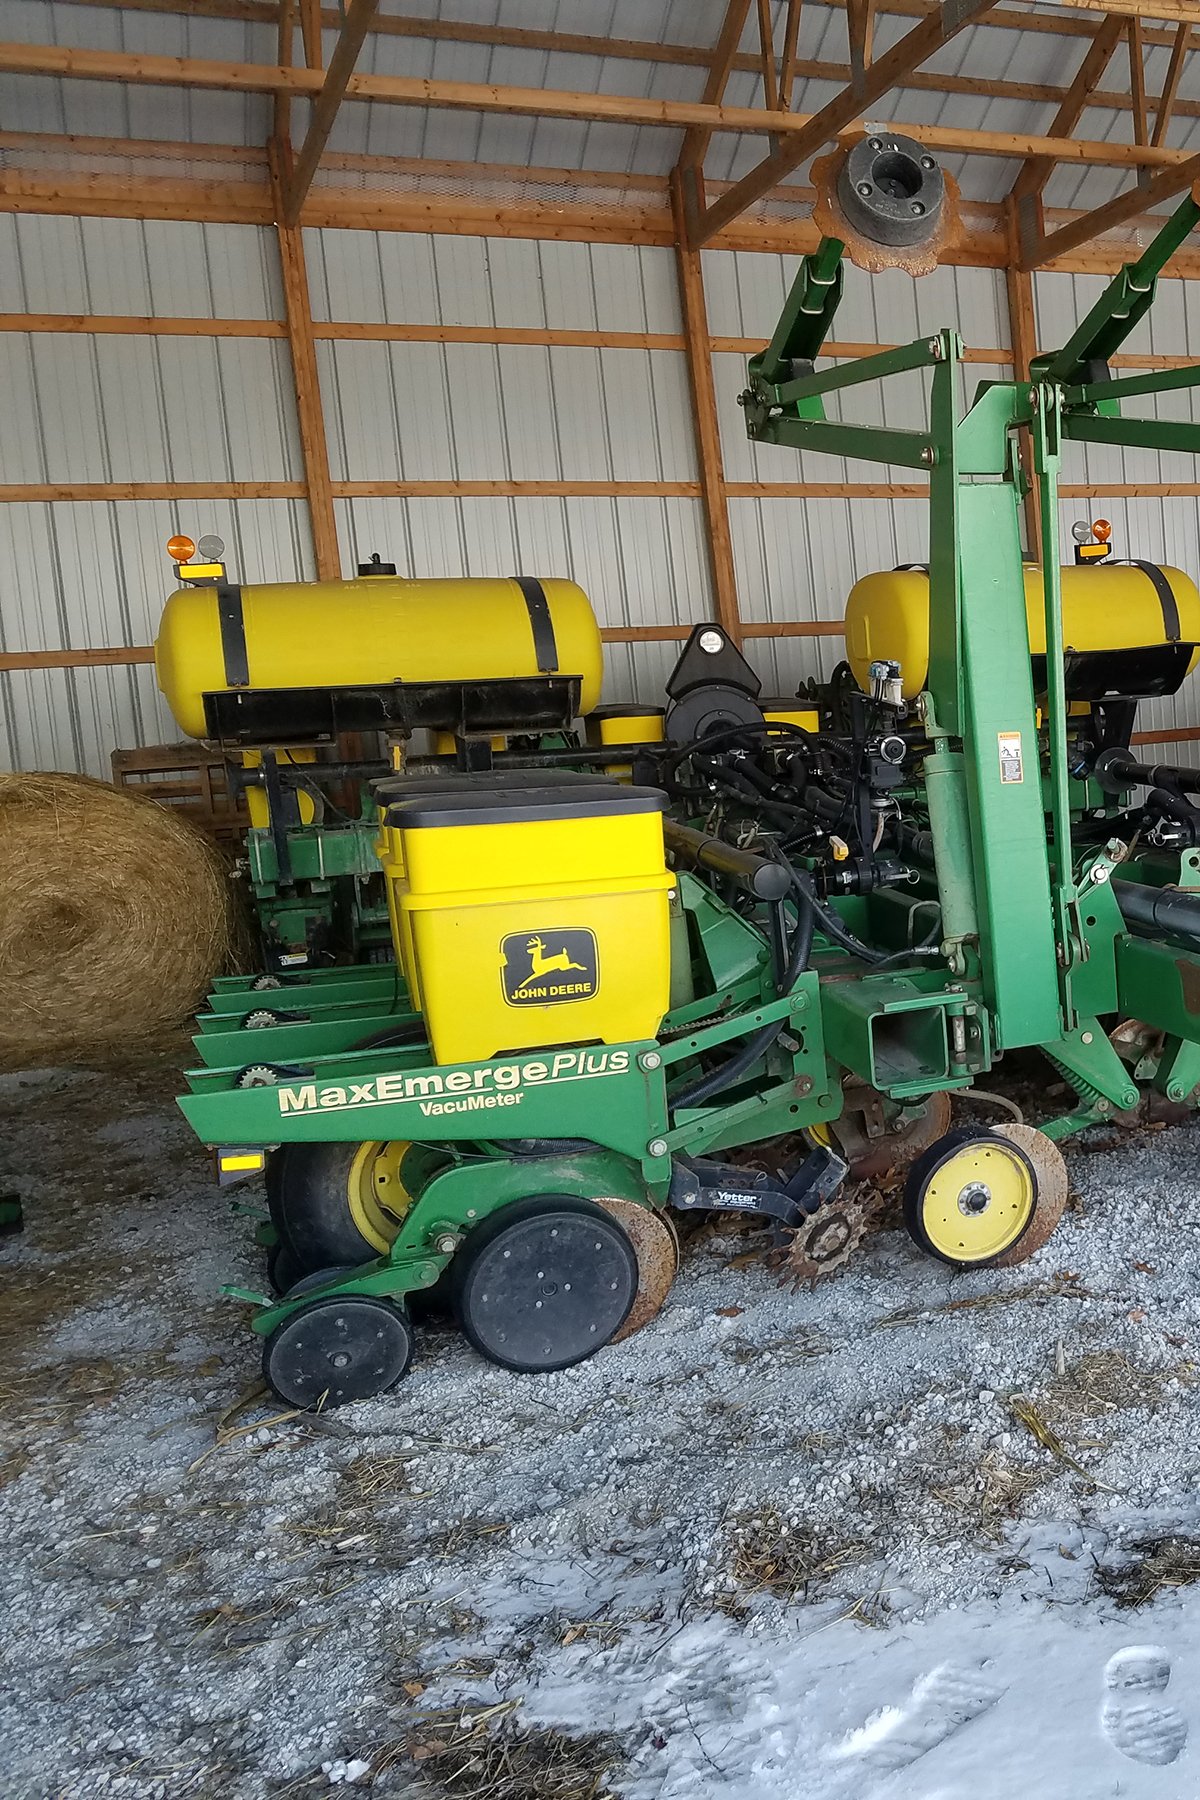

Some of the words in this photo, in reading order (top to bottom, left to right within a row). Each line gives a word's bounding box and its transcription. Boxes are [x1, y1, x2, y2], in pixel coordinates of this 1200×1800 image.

[511, 987, 547, 1000] JOHN
[549, 982, 592, 996] DEERE
[419, 1092, 524, 1117] VacuMeter
[717, 1191, 757, 1202] Yetter
